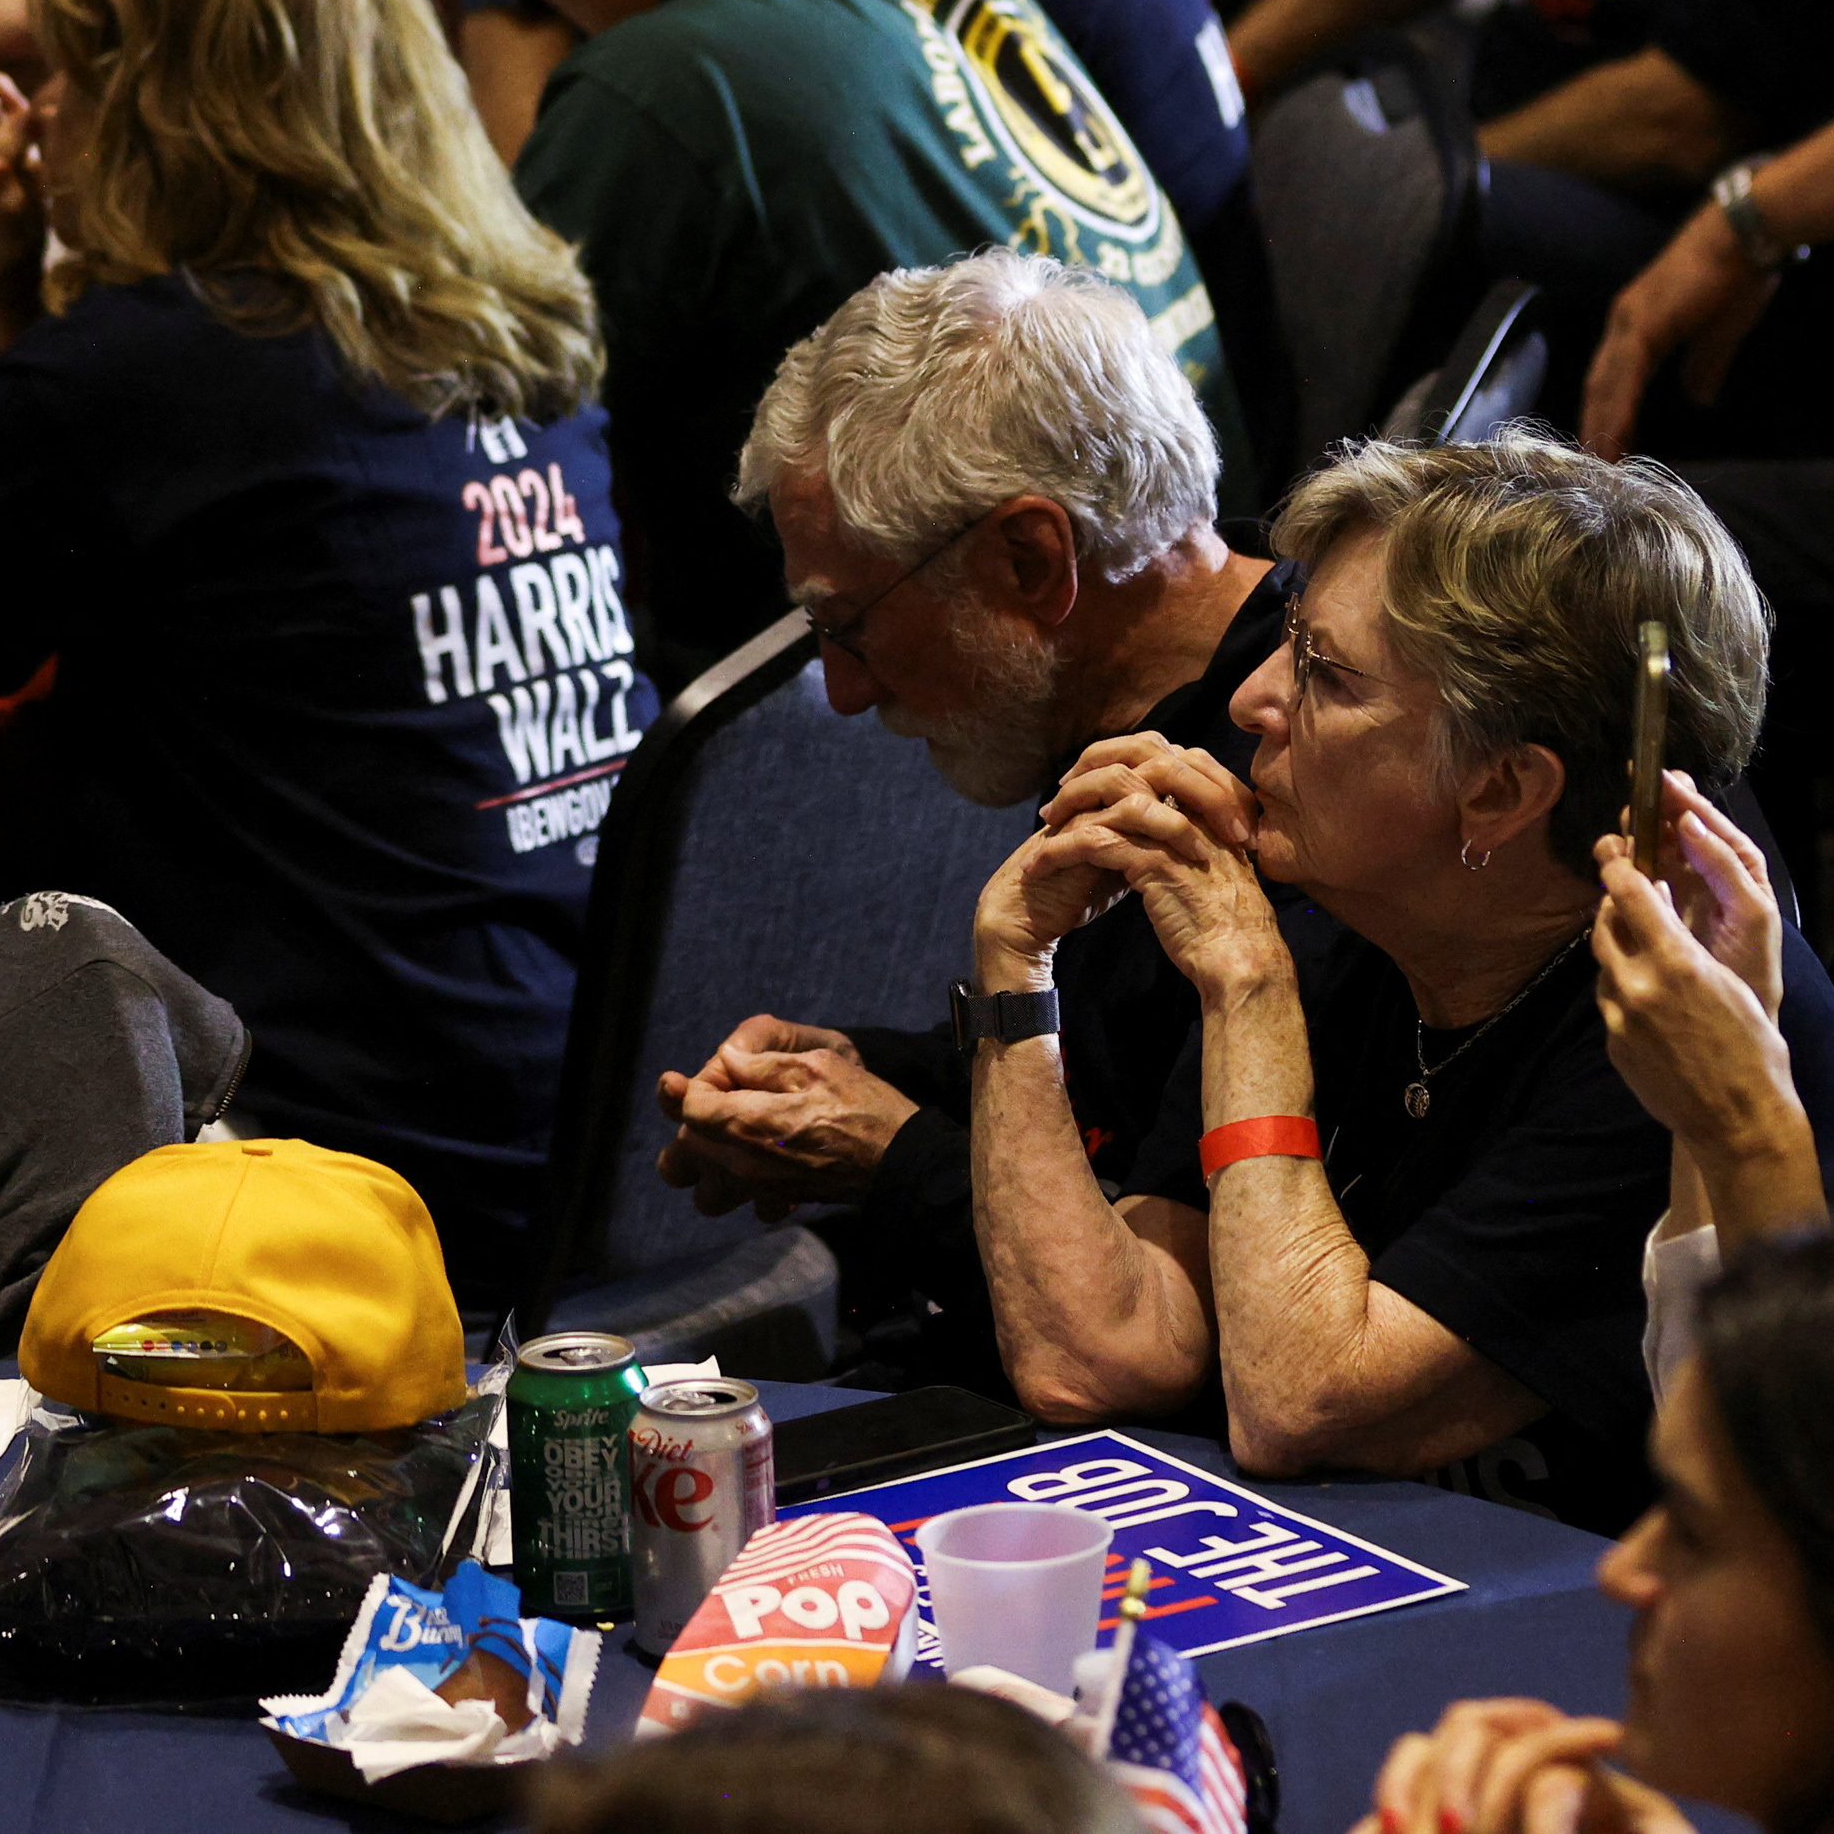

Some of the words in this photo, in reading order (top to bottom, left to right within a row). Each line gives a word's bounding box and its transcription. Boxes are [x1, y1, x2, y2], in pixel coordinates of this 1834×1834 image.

[462, 462, 585, 566] 2024
[411, 544, 634, 704] HARRIS
[487, 659, 643, 784] WALZ
[553, 1407, 610, 1429] Sprite
[636, 1425, 694, 1462] Diet
[543, 1445, 618, 1471] OBEY
[546, 1481, 621, 1516] YOUR
[1007, 1457, 1239, 1532] JOB
[1143, 1521, 1381, 1610] THE
[703, 1655, 849, 1693] Corn
